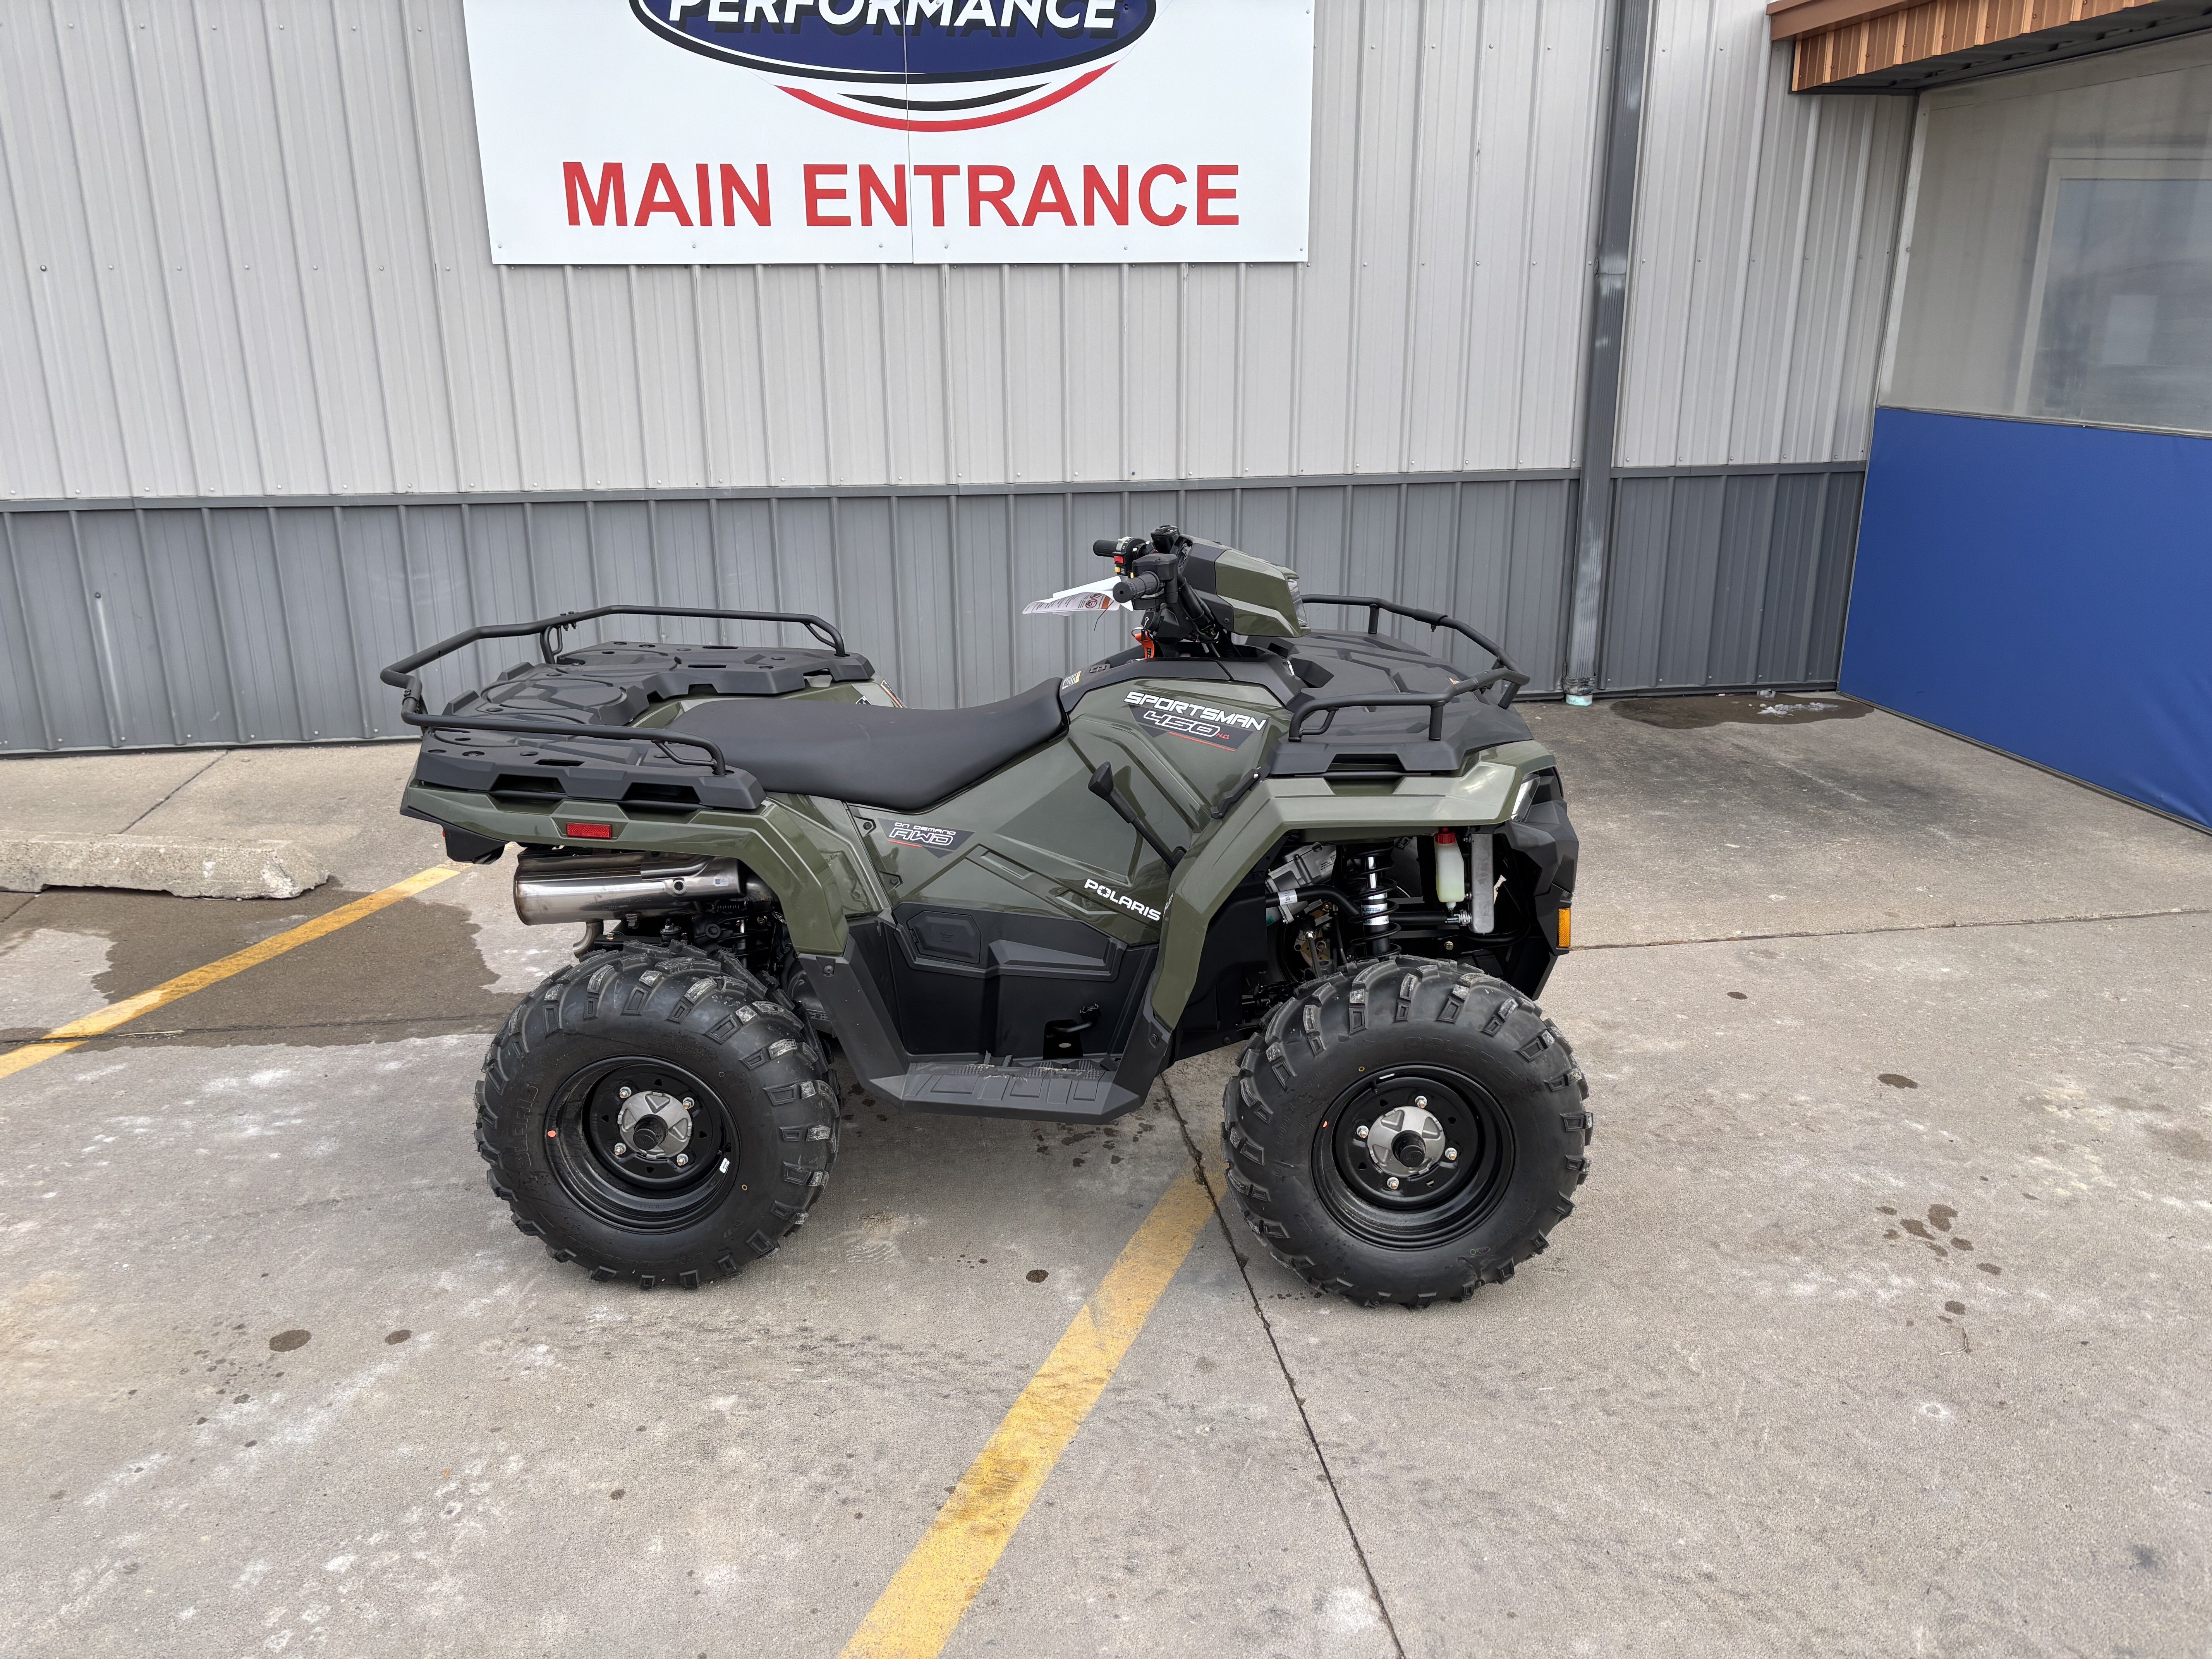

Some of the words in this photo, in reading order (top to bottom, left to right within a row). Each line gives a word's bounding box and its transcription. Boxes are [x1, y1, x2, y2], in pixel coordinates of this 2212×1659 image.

[563, 162, 771, 227] MAIN
[804, 165, 1239, 227] ENTRANCE
[1124, 691, 1266, 731] SPORTSMAN
[1143, 710, 1221, 737] 450
[889, 827, 953, 846] AWD
[1084, 879, 1161, 921] POLARIS
[512, 1082, 539, 1184] OLARIS
